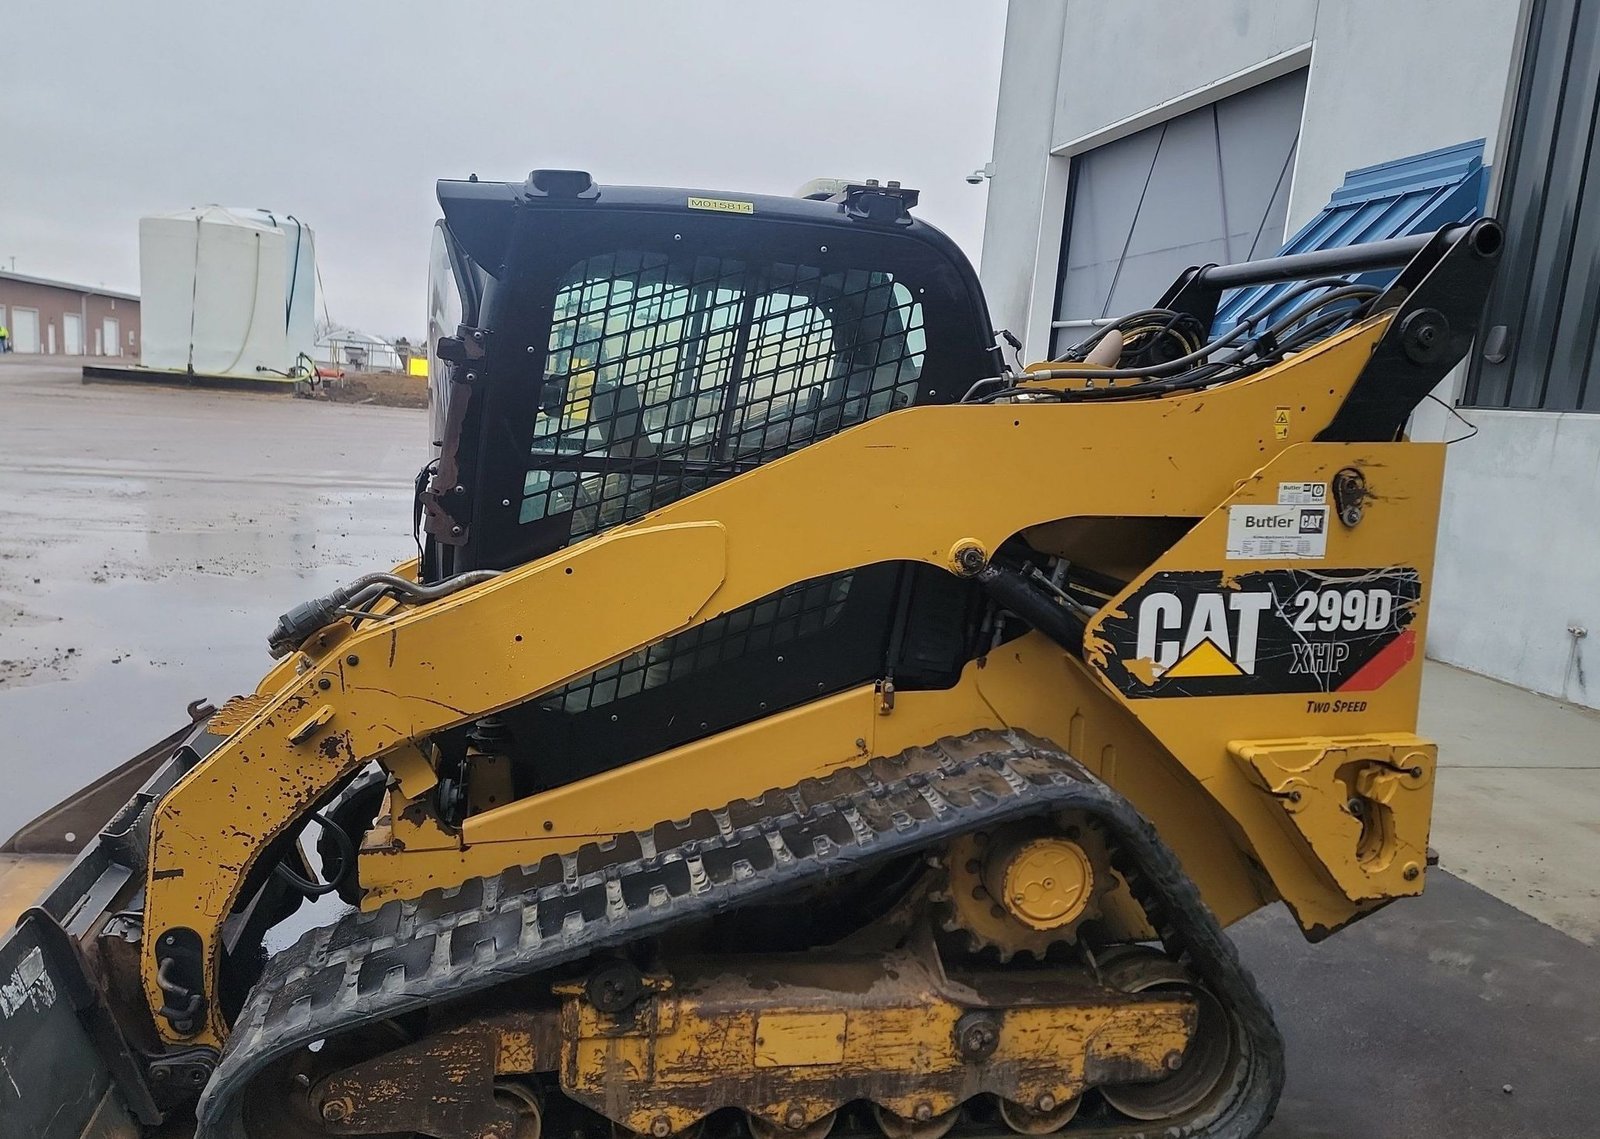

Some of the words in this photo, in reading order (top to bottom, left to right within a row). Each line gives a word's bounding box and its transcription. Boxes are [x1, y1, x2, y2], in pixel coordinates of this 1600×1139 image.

[1245, 515, 1294, 528] Butler
[1300, 514, 1323, 529] CAT
[1293, 589, 1392, 631] 299D
[1136, 592, 1272, 678] CAT
[1289, 643, 1350, 674] XHP
